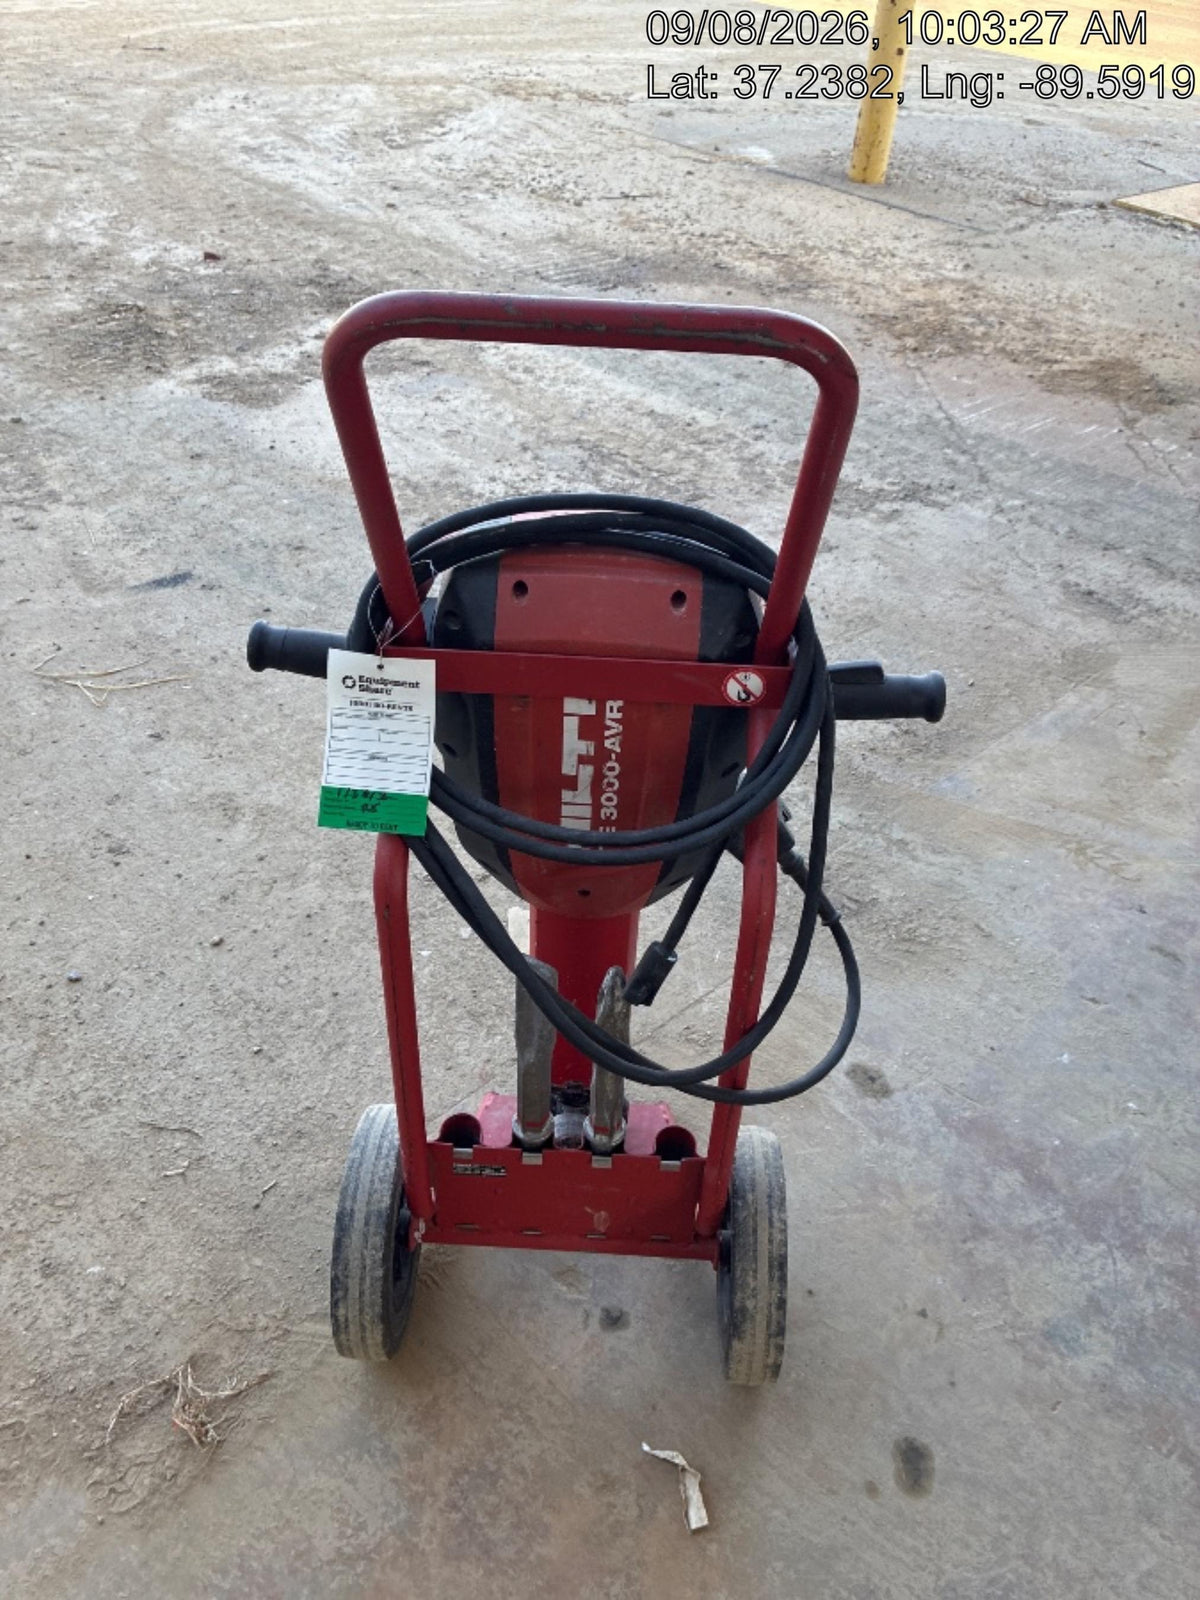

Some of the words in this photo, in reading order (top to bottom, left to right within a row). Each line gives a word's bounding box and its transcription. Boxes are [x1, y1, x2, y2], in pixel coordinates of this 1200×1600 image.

[358, 675, 420, 689] Equipment
[358, 684, 393, 695] Share
[600, 699, 625, 821] 3000-AVR
